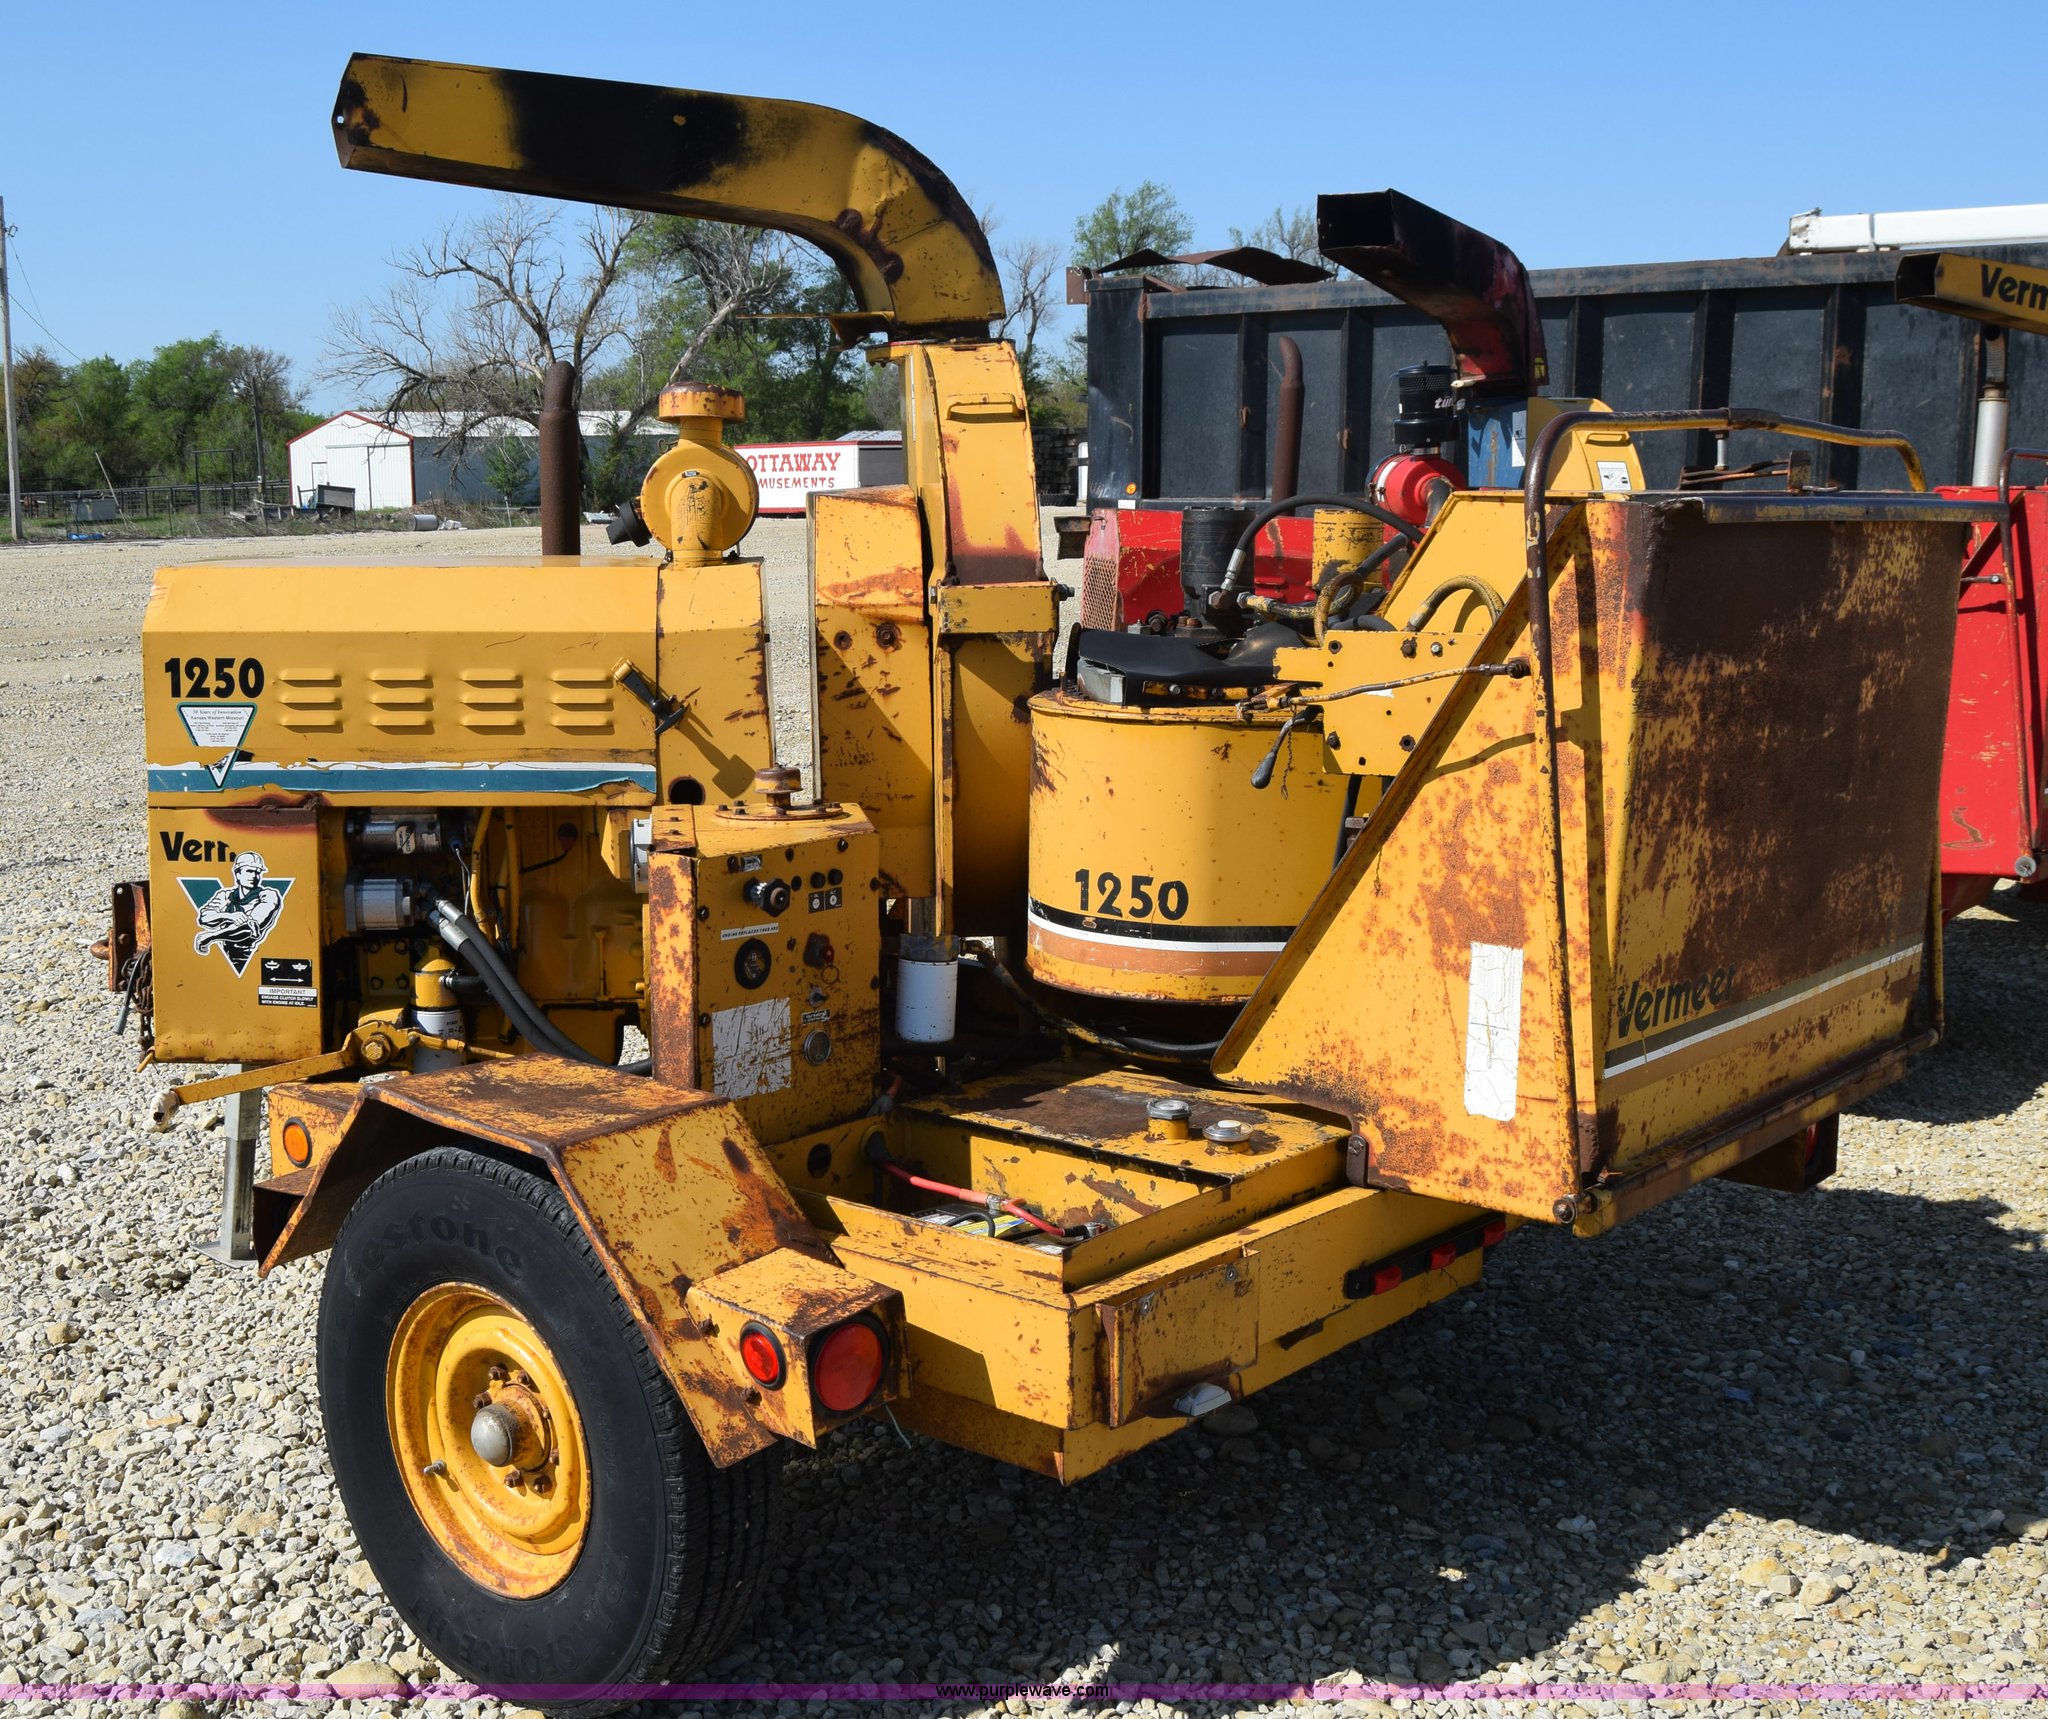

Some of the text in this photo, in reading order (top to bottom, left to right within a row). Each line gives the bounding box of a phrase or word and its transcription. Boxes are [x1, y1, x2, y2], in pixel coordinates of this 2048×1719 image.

[747, 452, 841, 473] OTTAWAY
[758, 476, 835, 489] MUSEMENTS
[164, 657, 265, 699] 1250
[1075, 868, 1189, 921] 1250
[1616, 961, 1737, 1039] Vermeer
